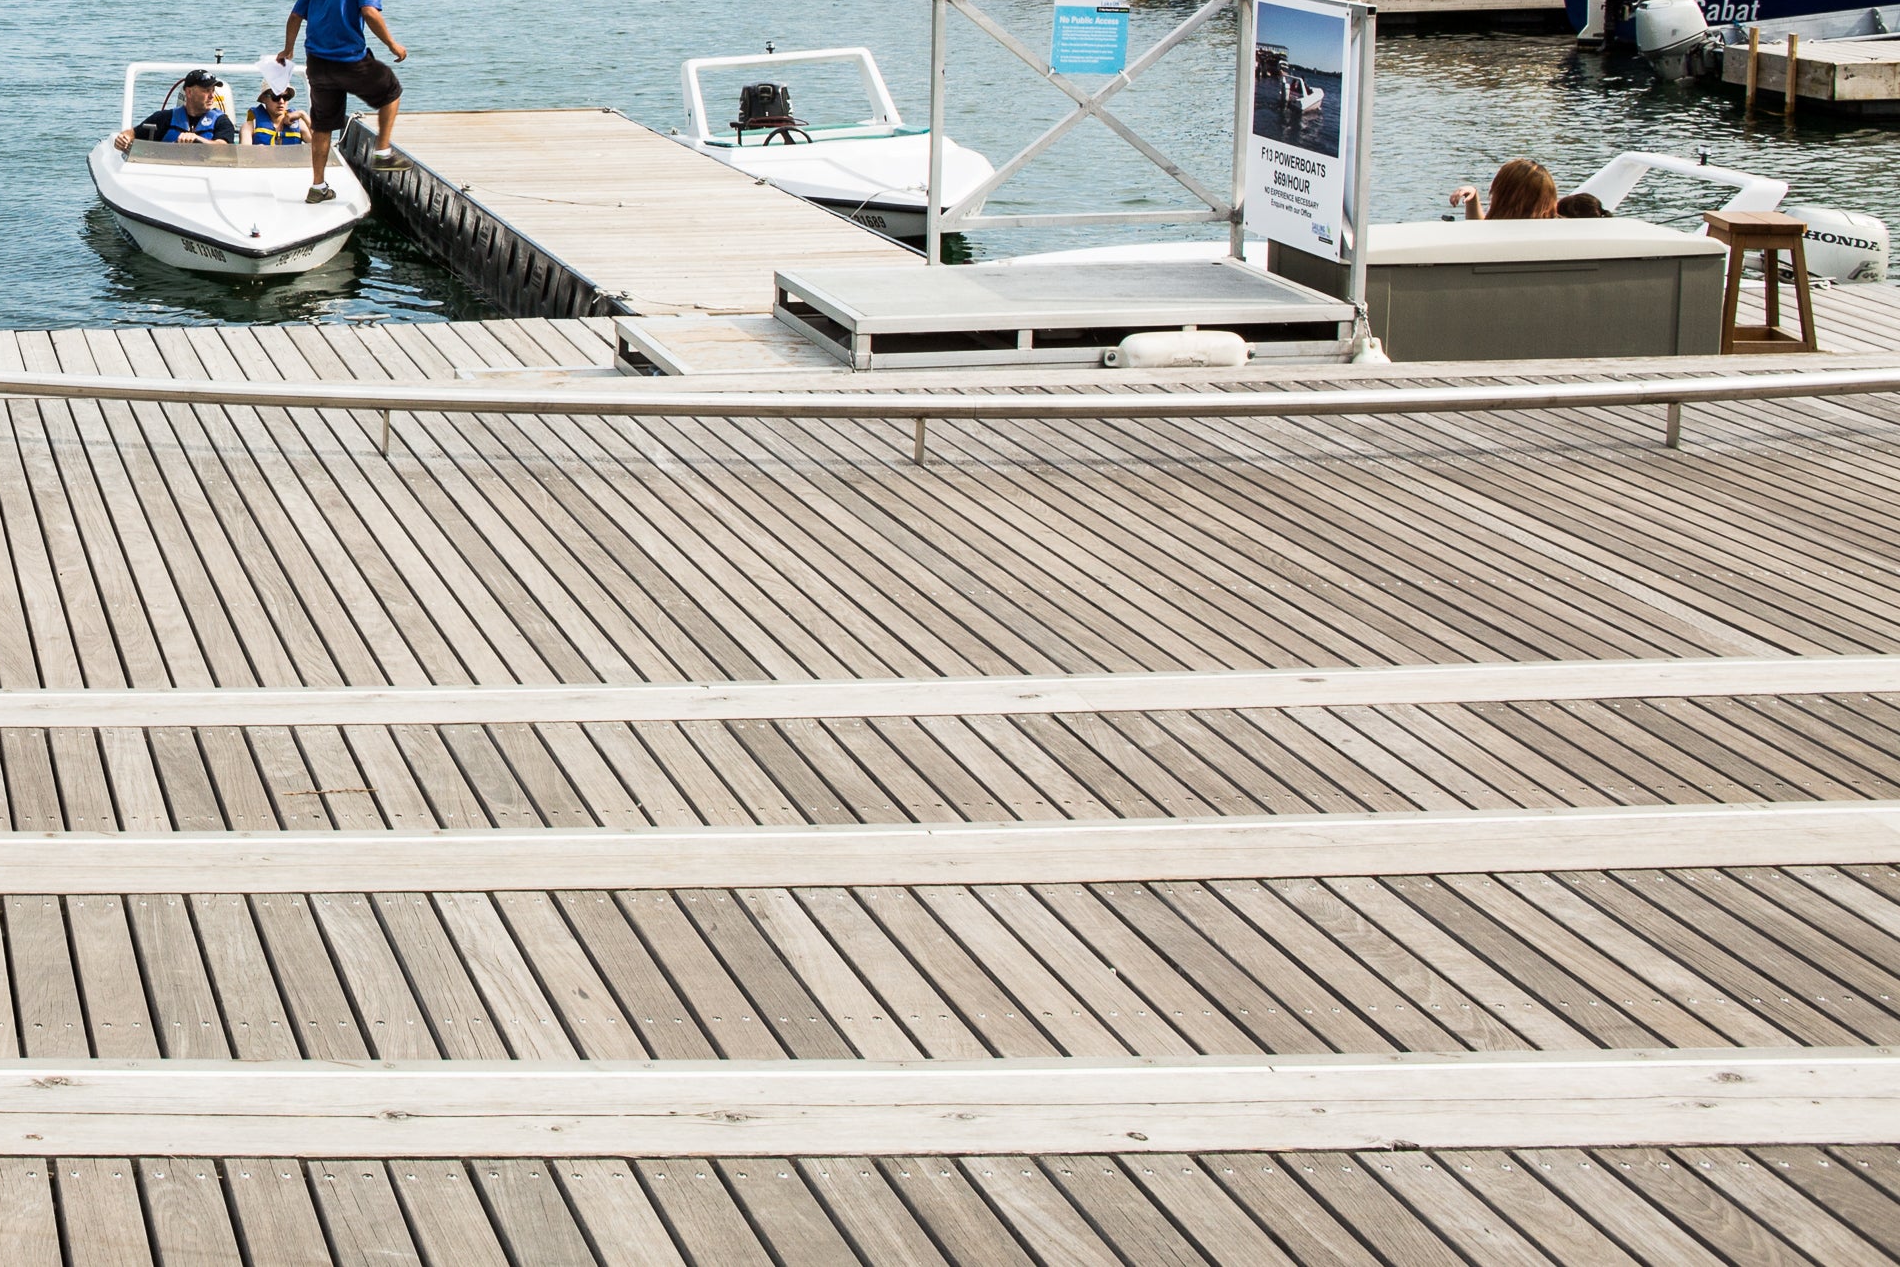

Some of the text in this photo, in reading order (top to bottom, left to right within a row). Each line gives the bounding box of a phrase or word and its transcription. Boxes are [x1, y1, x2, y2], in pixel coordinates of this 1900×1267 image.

[1059, 16, 1119, 25] No Public Access
[1261, 146, 1326, 178] F13 POWERBOATS
[1273, 170, 1311, 195] $69/HOUR
[1264, 186, 1319, 210] NO EXPERIENCE NECESSARY
[1285, 203, 1293, 212] with
[1300, 208, 1312, 219] Office
[1802, 229, 1881, 252] HONDA
